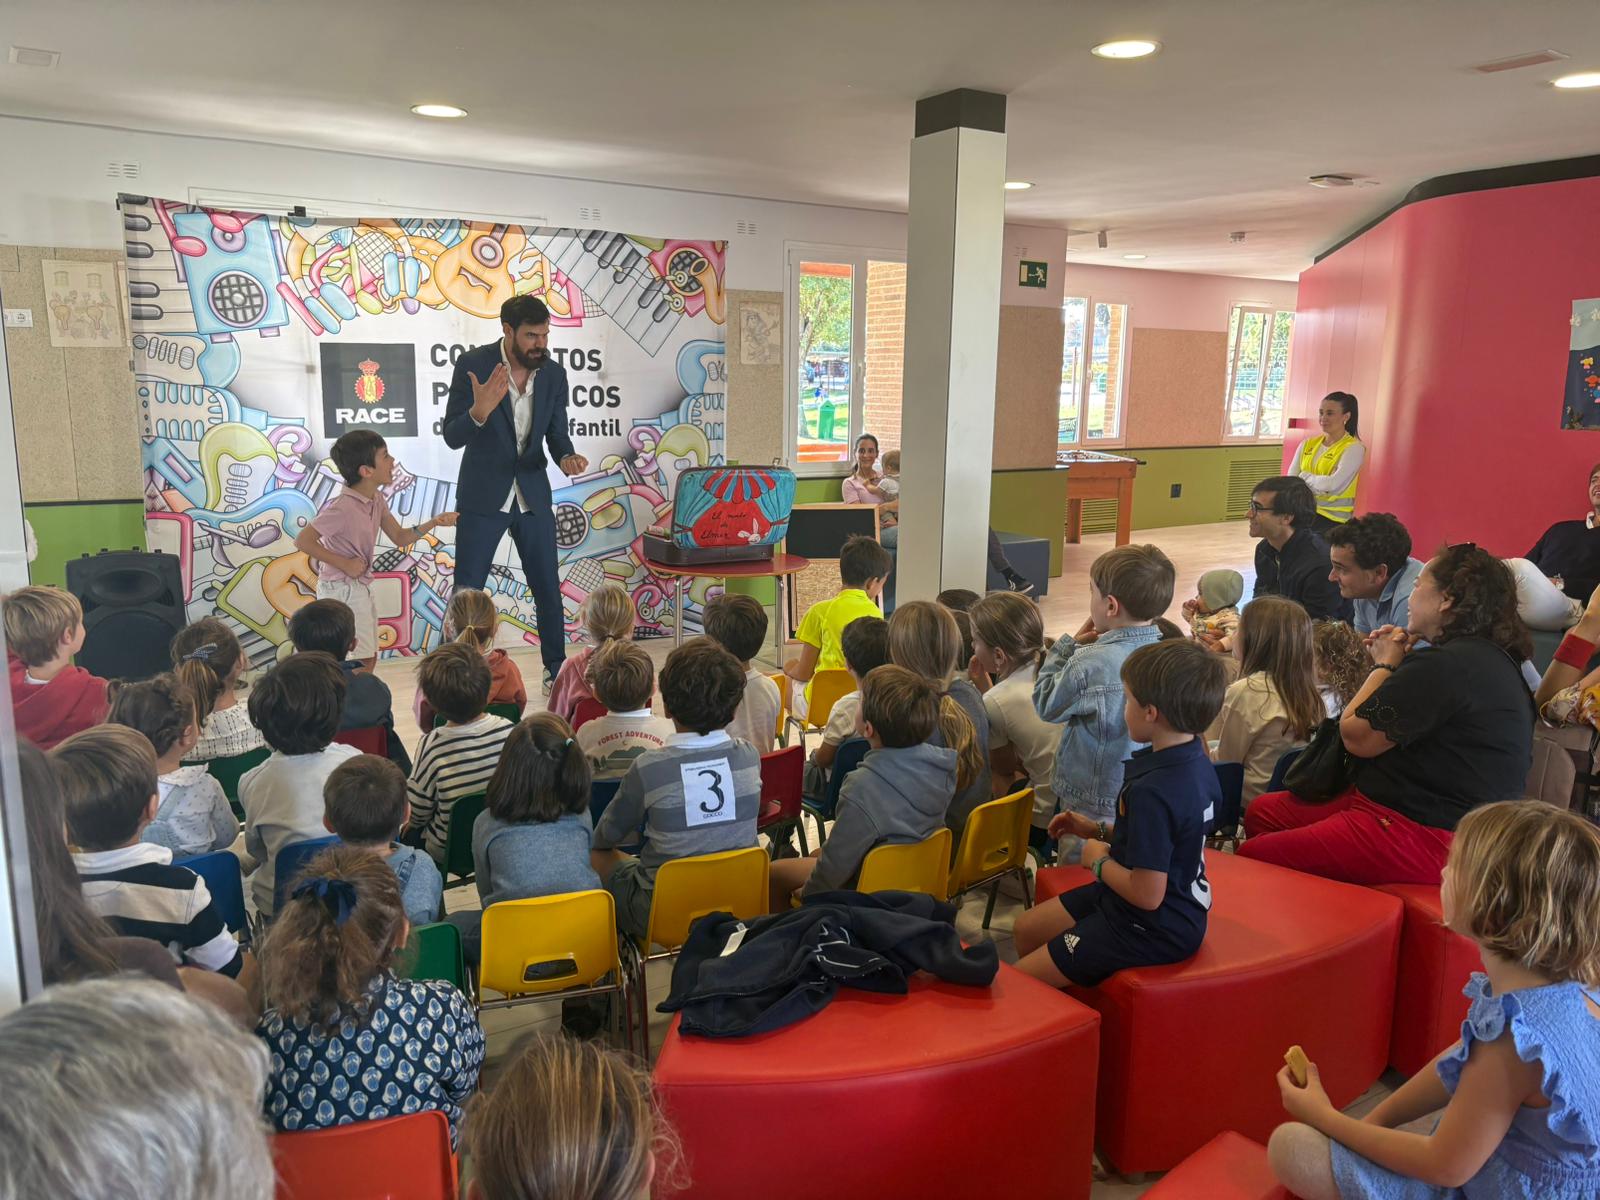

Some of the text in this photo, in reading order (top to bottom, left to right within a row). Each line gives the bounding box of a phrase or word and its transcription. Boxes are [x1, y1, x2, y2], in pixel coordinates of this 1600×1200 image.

[335, 407, 407, 424] RACE
[568, 418, 621, 436] fantil
[598, 730, 664, 746] FOREST ADVENTURE
[697, 769, 725, 813] 3
